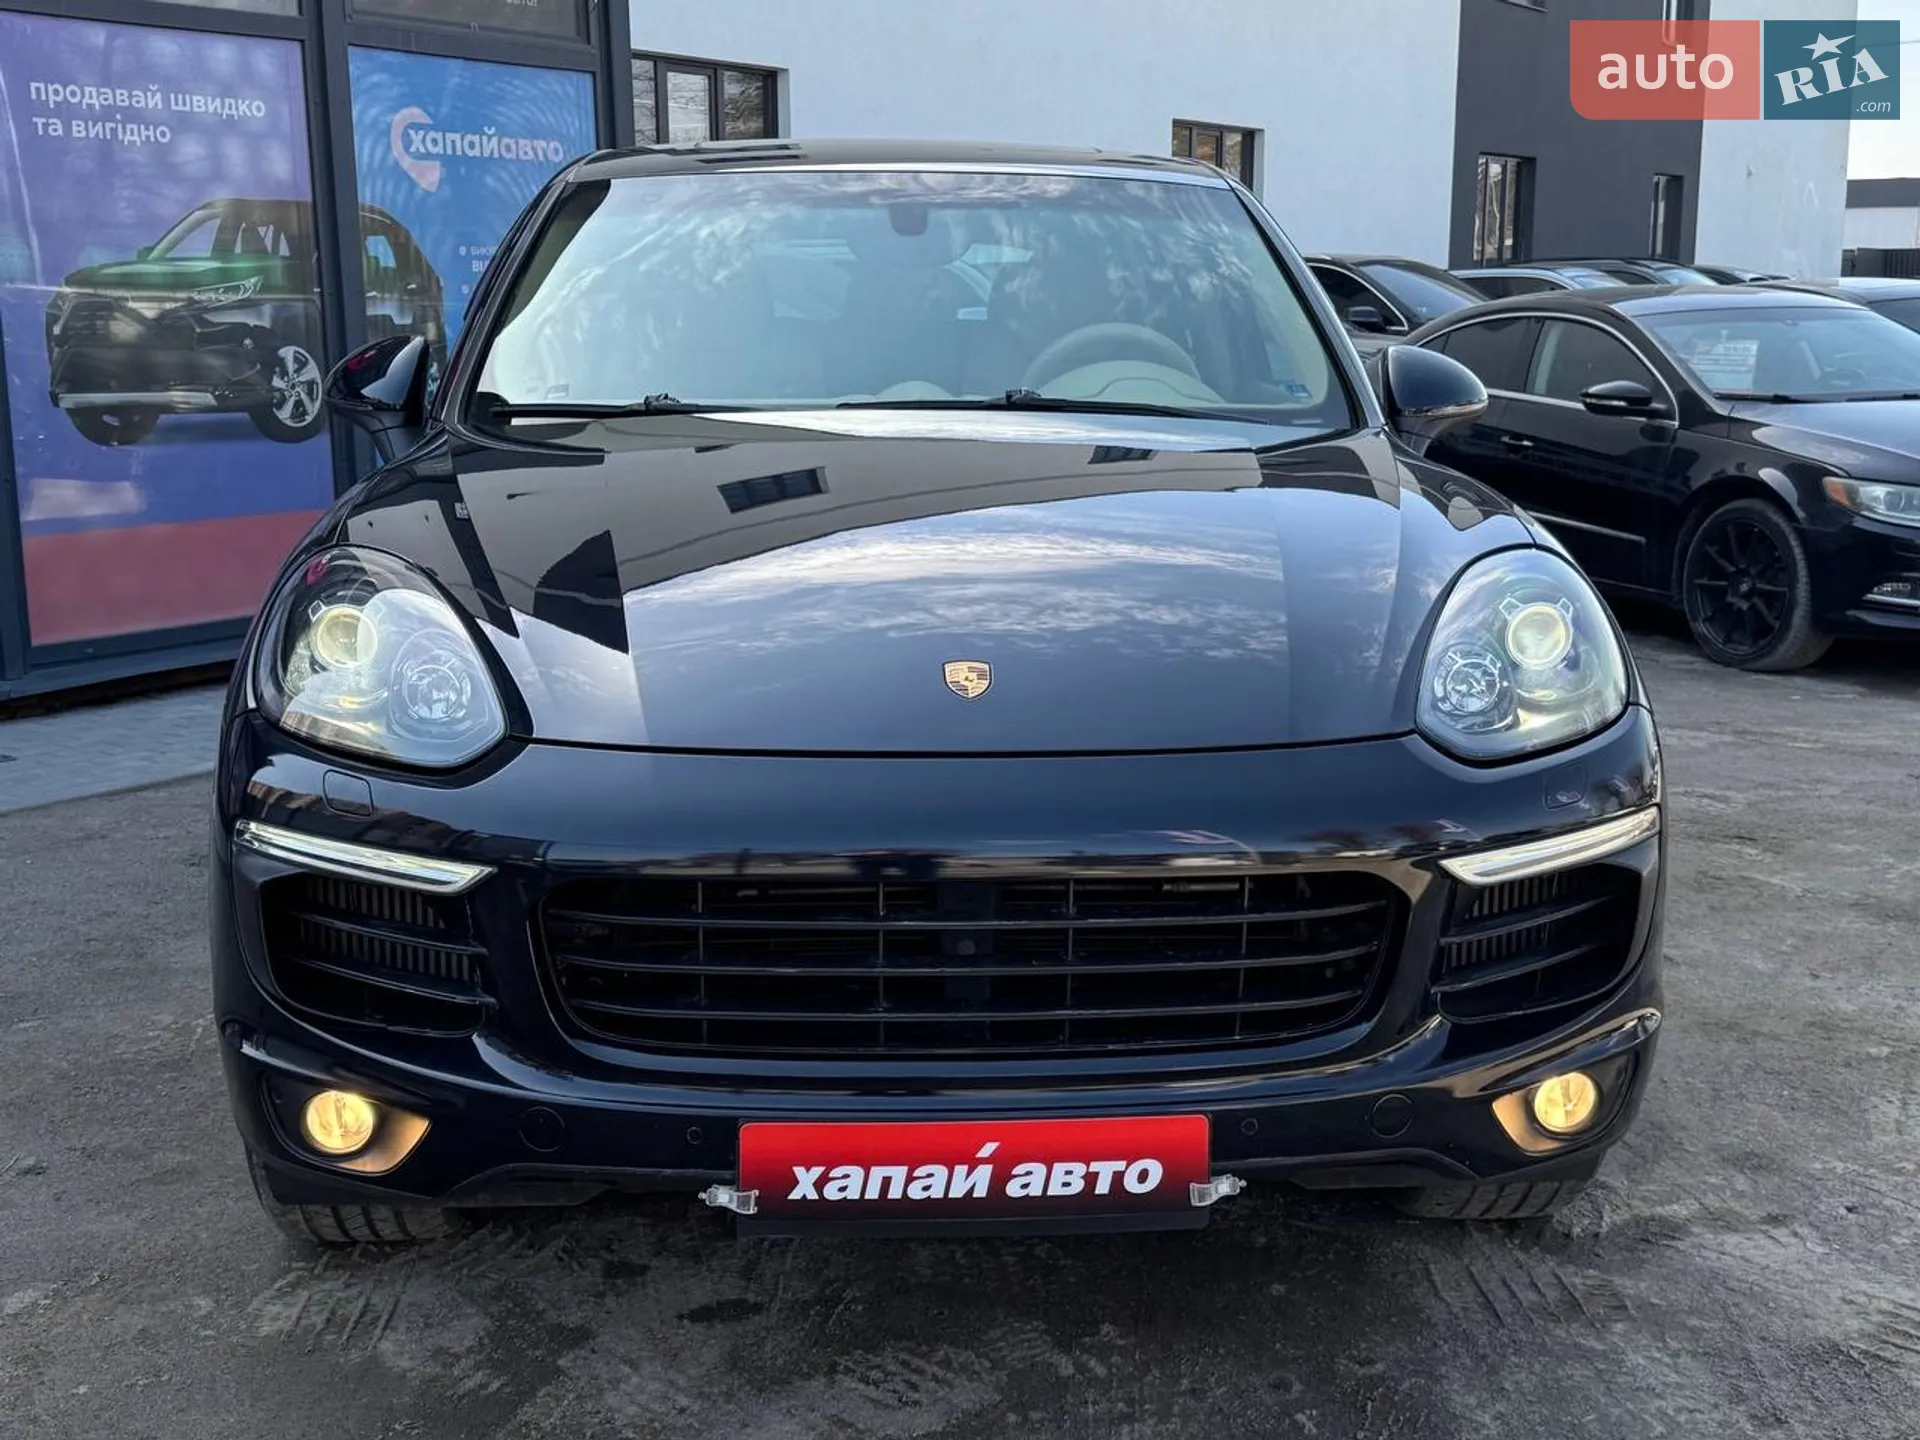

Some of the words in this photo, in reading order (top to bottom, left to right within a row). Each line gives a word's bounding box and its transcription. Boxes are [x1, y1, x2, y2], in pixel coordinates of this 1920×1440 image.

[29, 82, 162, 111] продавай
[170, 92, 266, 120] швидко
[32, 116, 64, 137] та
[71, 113, 172, 146] вигідно
[1005, 1158, 1164, 1197] авто
